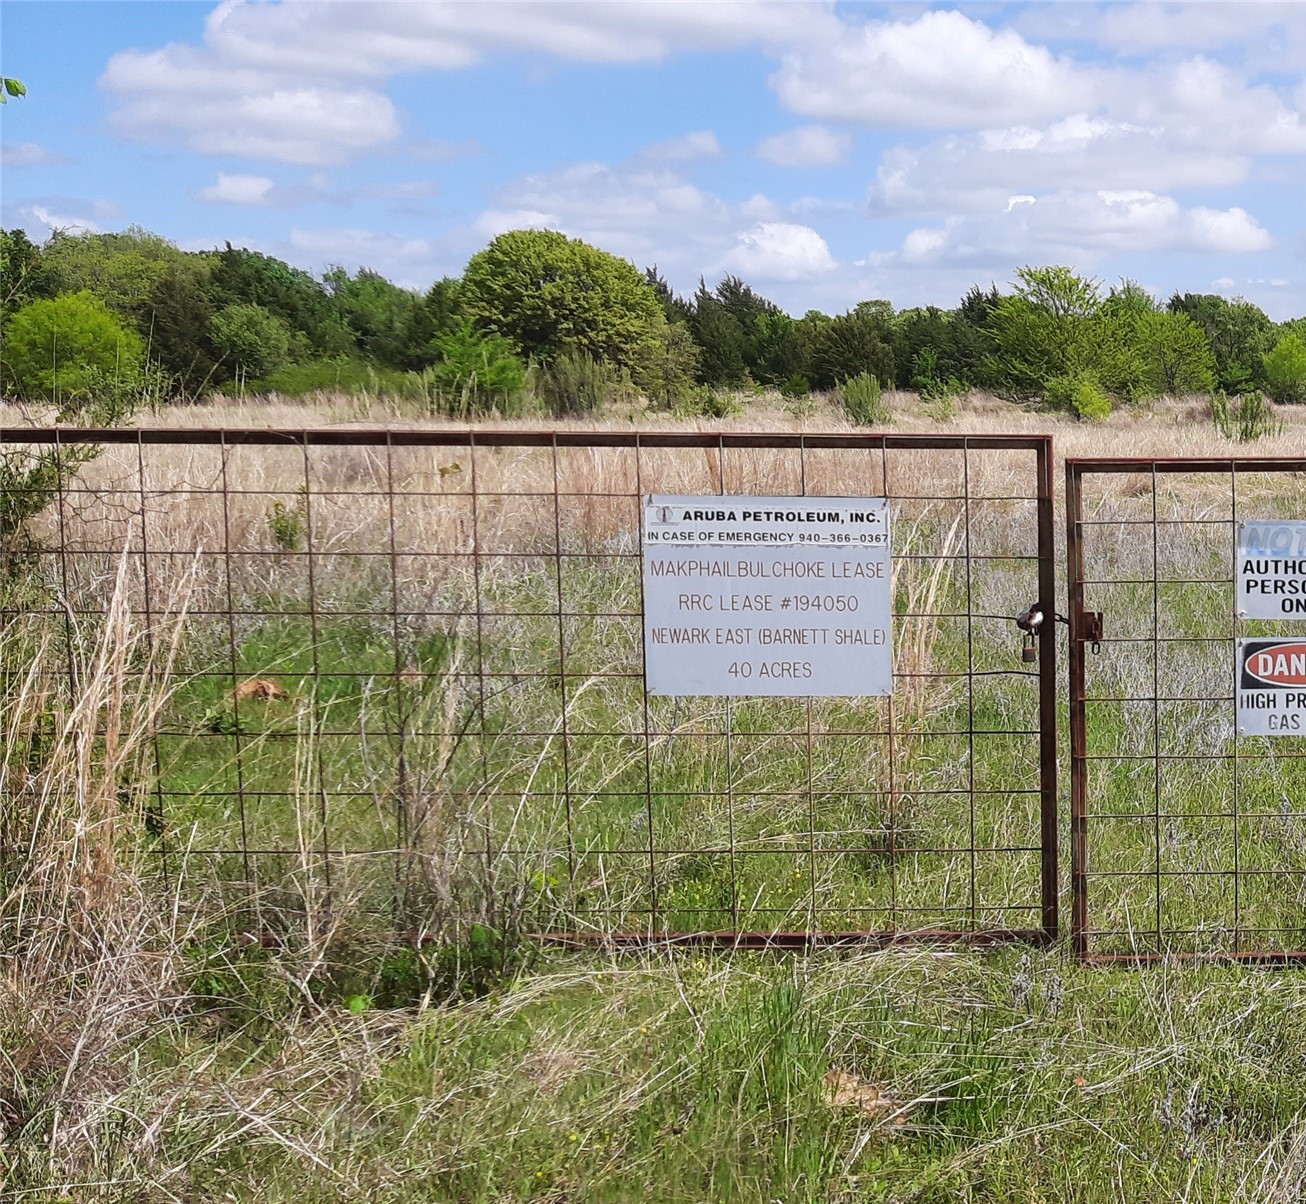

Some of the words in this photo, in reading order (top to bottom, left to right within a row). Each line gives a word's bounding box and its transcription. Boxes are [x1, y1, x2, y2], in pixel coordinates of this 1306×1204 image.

[682, 510, 737, 522] ARUBA
[742, 511, 845, 525] PETROLEUM,
[849, 512, 881, 523] INC.
[647, 531, 659, 541] IN
[662, 531, 695, 541] CASE
[698, 532, 715, 541] OF
[718, 532, 795, 542] EMERGENCY
[798, 533, 889, 543] 940-366-0367
[831, 561, 885, 579] LEASE
[678, 594, 714, 611] RRC
[720, 594, 773, 612] LEASE
[780, 595, 859, 612] #194050
[652, 628, 710, 645] NEWARK
[715, 628, 752, 645] EAST
[758, 628, 829, 646] (BARNETT
[835, 629, 886, 646] SHALE)
[728, 662, 752, 678] 40
[758, 662, 812, 679] ACRES
[1240, 692, 1277, 709] HIGH
[1268, 713, 1300, 730] GAS
